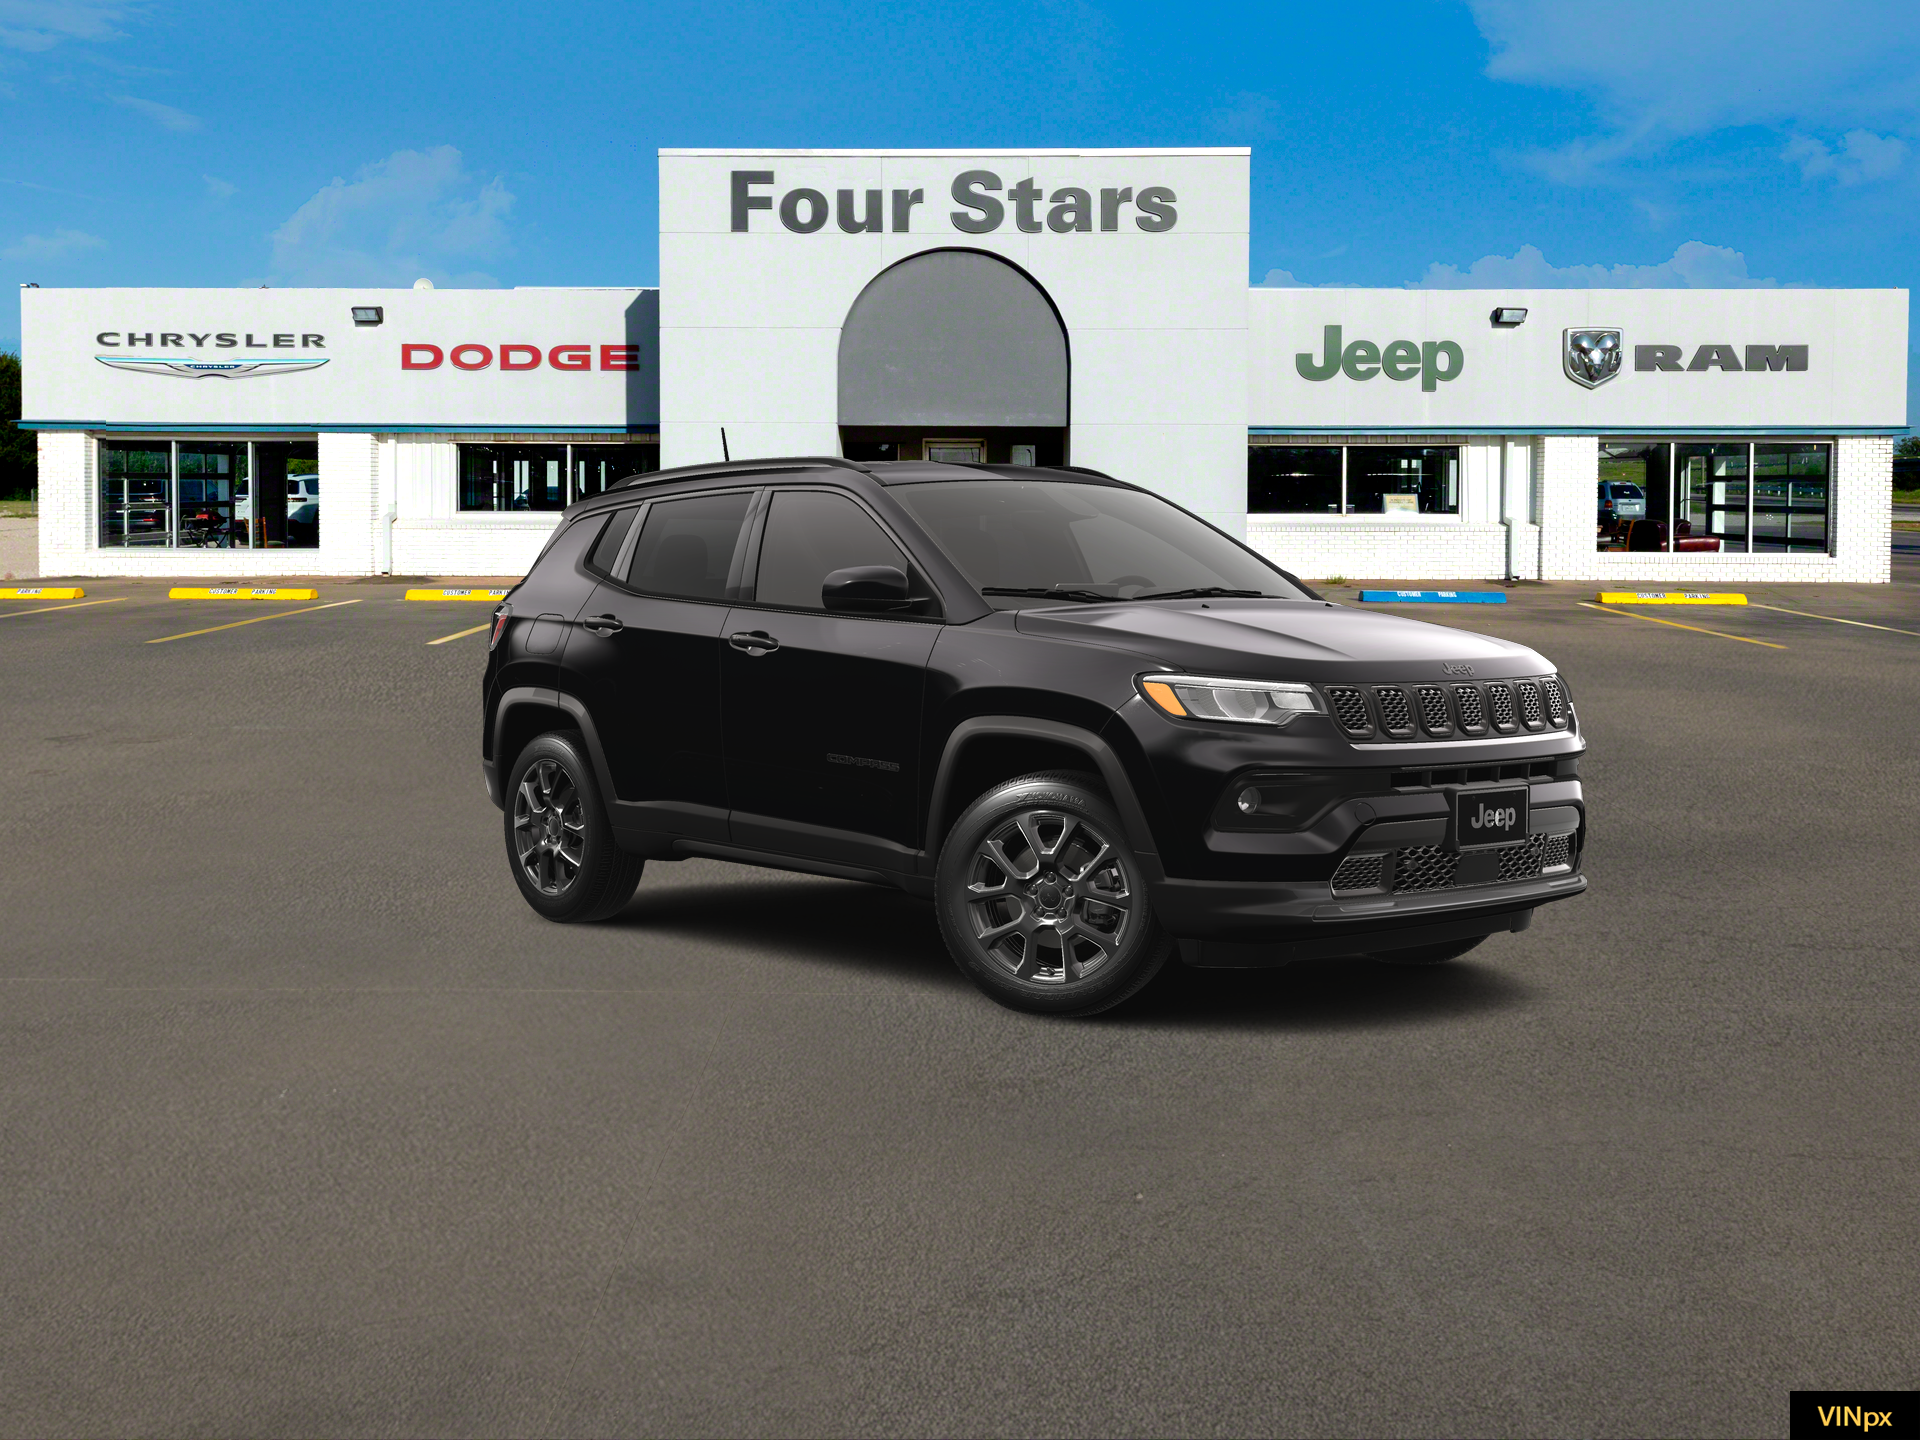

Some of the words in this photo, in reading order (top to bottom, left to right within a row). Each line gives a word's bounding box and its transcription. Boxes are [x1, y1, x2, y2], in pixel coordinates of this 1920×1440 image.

[730, 169, 925, 234] Four
[950, 169, 1178, 234] Stars
[96, 331, 326, 348] CHRYSLER
[401, 343, 640, 371] DODGE
[1295, 324, 1464, 393] Jeep
[1634, 344, 1809, 372] RAM
[1443, 662, 1475, 677] Jeep
[826, 752, 900, 772] COMPASS
[1471, 803, 1516, 831] Jeep
